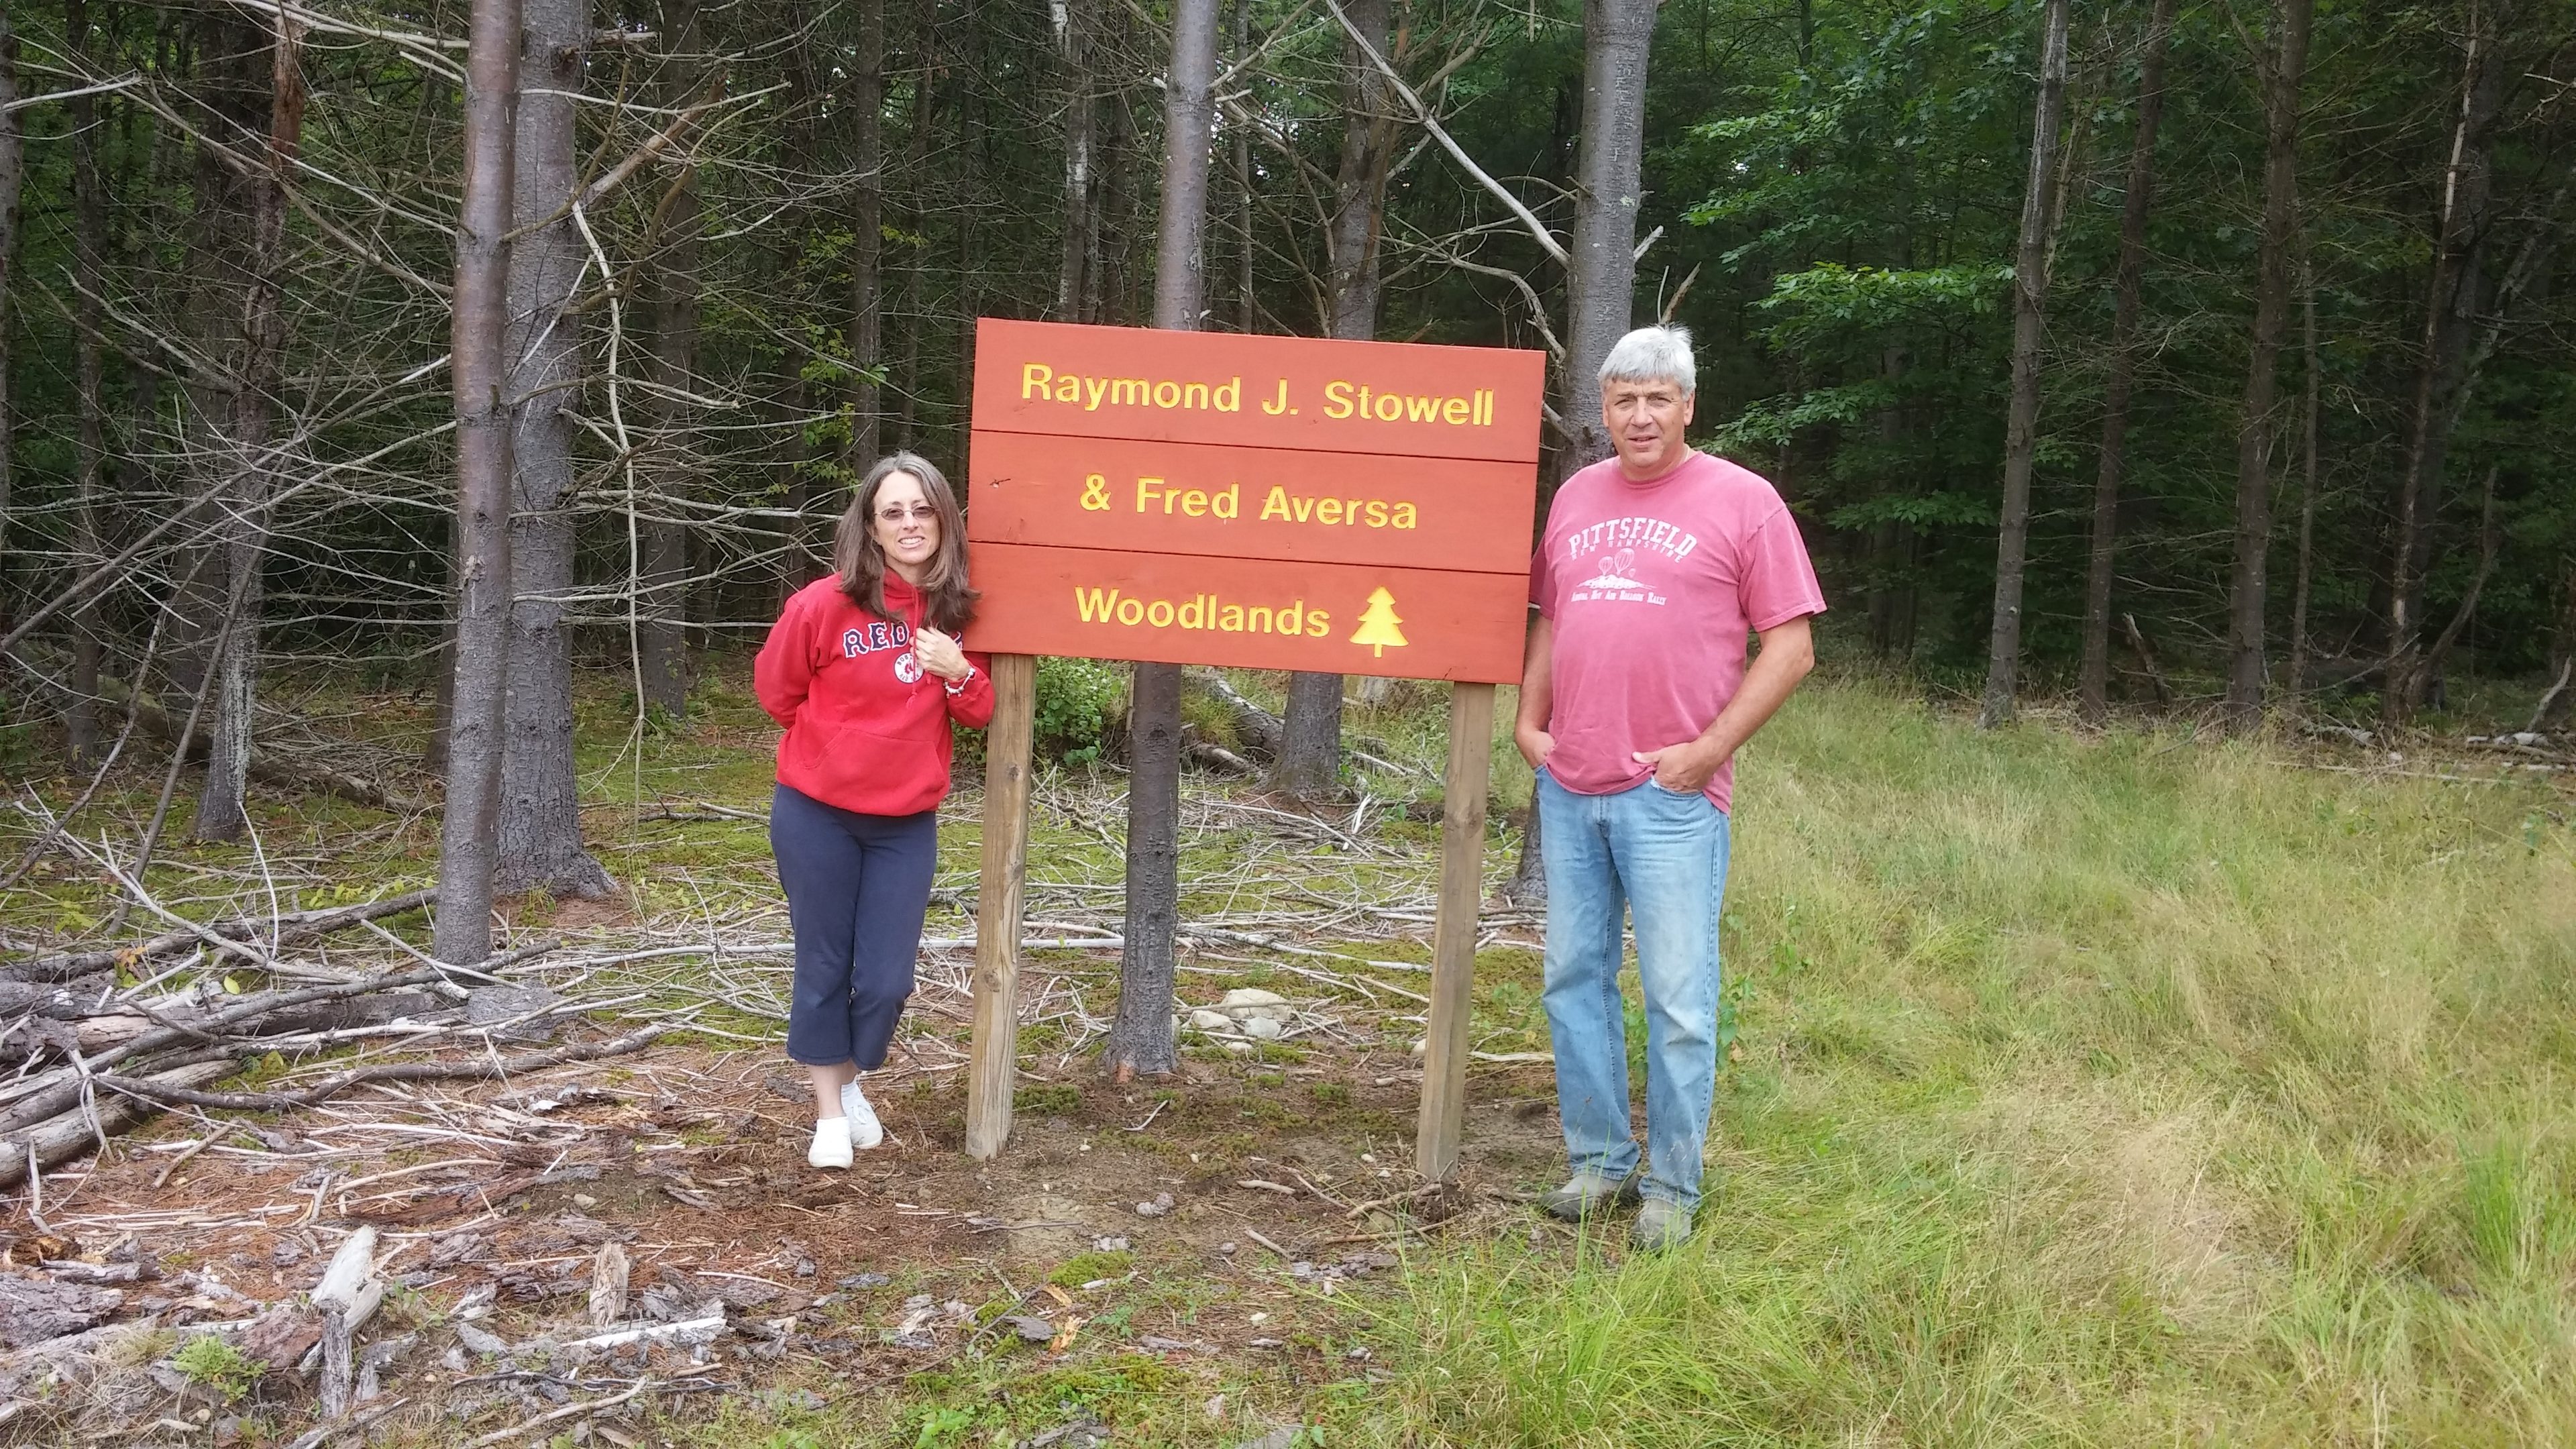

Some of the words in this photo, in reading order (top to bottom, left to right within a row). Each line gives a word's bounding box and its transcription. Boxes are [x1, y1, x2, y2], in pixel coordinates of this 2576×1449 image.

[1022, 364, 1240, 413] Raymond
[1262, 379, 1299, 415] J.
[1323, 380, 1494, 426] Stowell
[1079, 472, 1112, 511] &
[1135, 476, 1240, 519] Fred
[1259, 486, 1417, 530] Aversa
[1568, 517, 1697, 555] PITTSFIELD
[1075, 586, 1331, 638] Woodlands
[843, 621, 910, 658] RED
